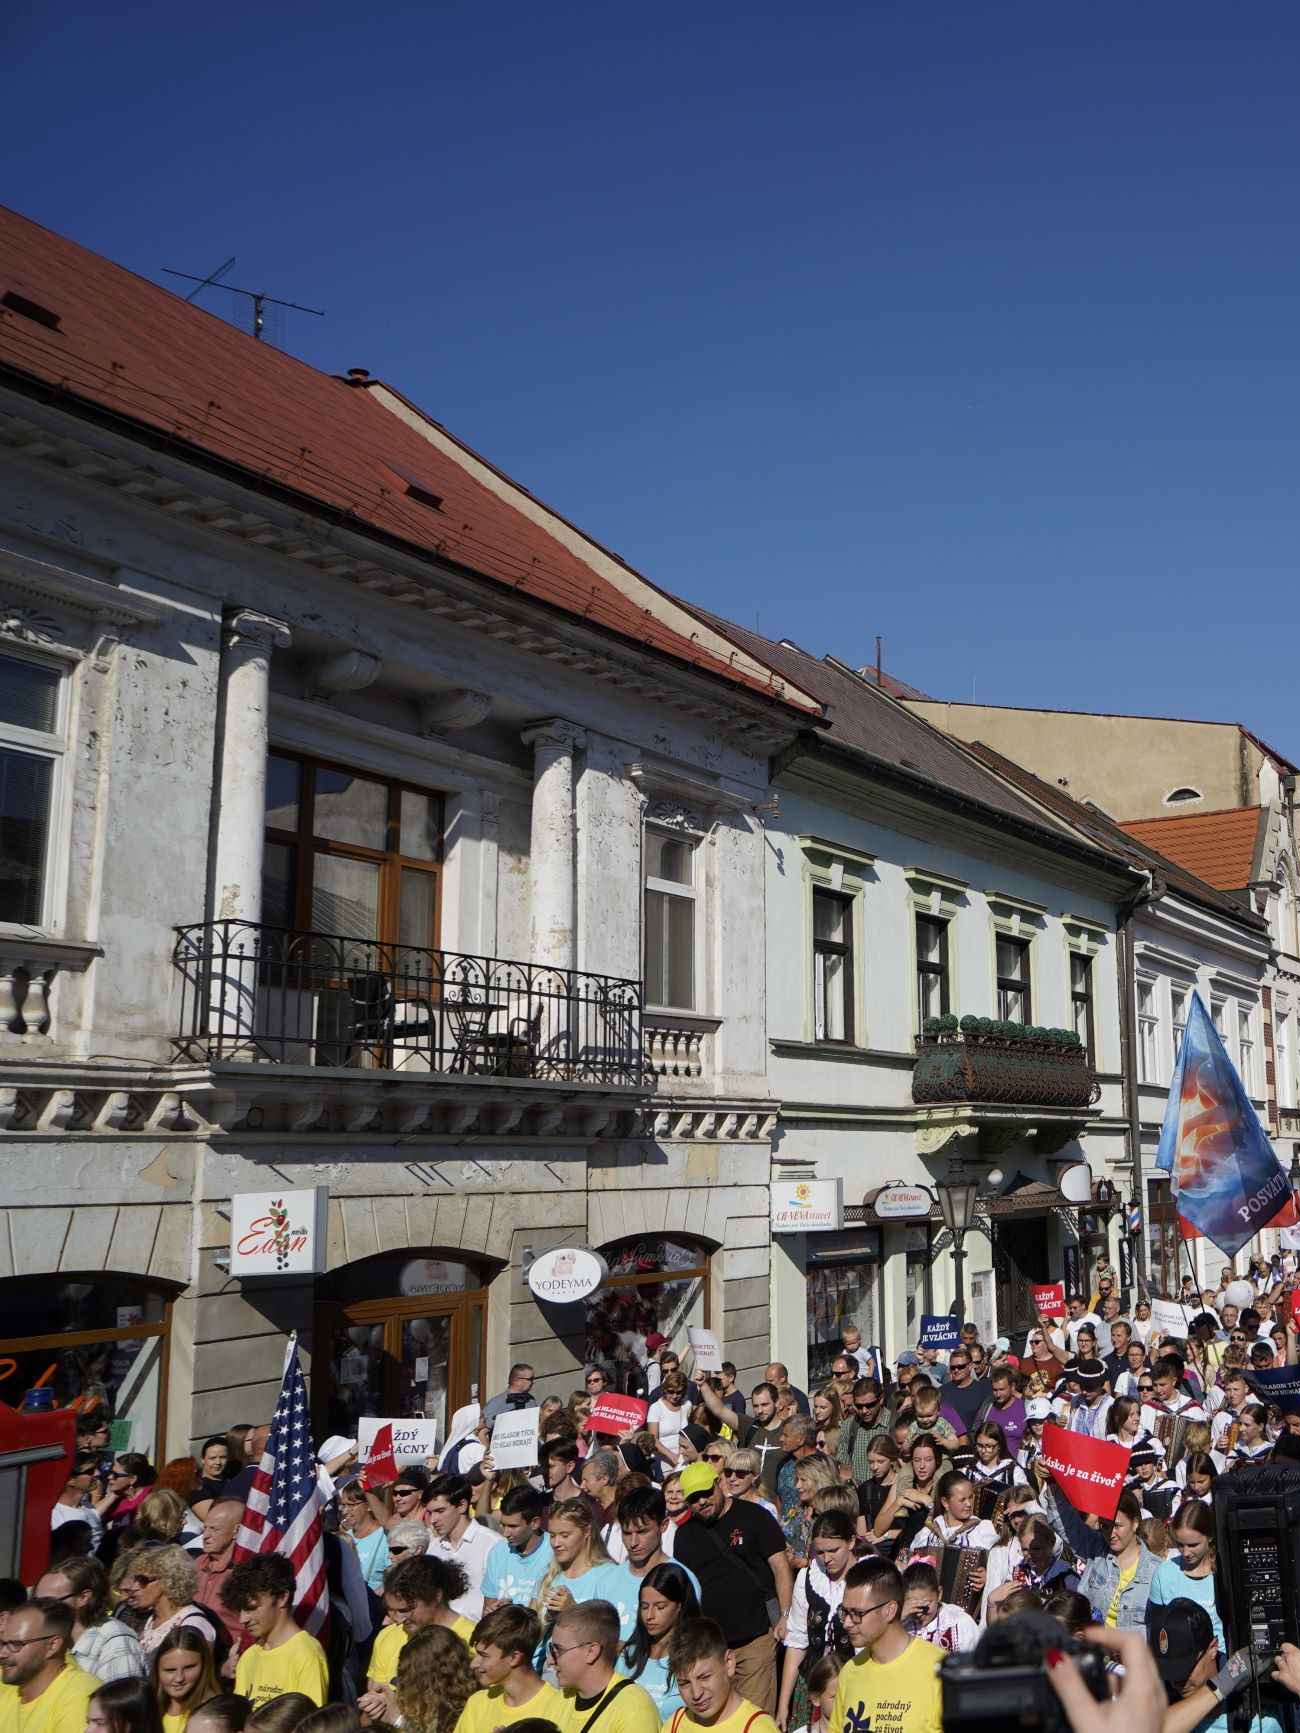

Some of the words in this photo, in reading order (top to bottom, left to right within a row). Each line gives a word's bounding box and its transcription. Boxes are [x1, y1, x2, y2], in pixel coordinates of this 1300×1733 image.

[237, 1216, 308, 1256] Eden
[535, 1278, 592, 1290] YODEYMA
[1038, 1300, 1062, 1310] ZÁCNY
[927, 1322, 951, 1332] KAŽDÝ
[922, 1334, 929, 1343] JE
[929, 1331, 958, 1342] VZÁCNY
[600, 1411, 615, 1420] HLAS
[394, 1428, 420, 1441] ŽDÝ
[395, 1443, 429, 1454] ÁCNY
[1064, 1463, 1075, 1476] je
[1077, 1469, 1089, 1479] za
[877, 1700, 911, 1712] národný
[875, 1712, 903, 1723] pochod
[884, 1724, 903, 1733] život
